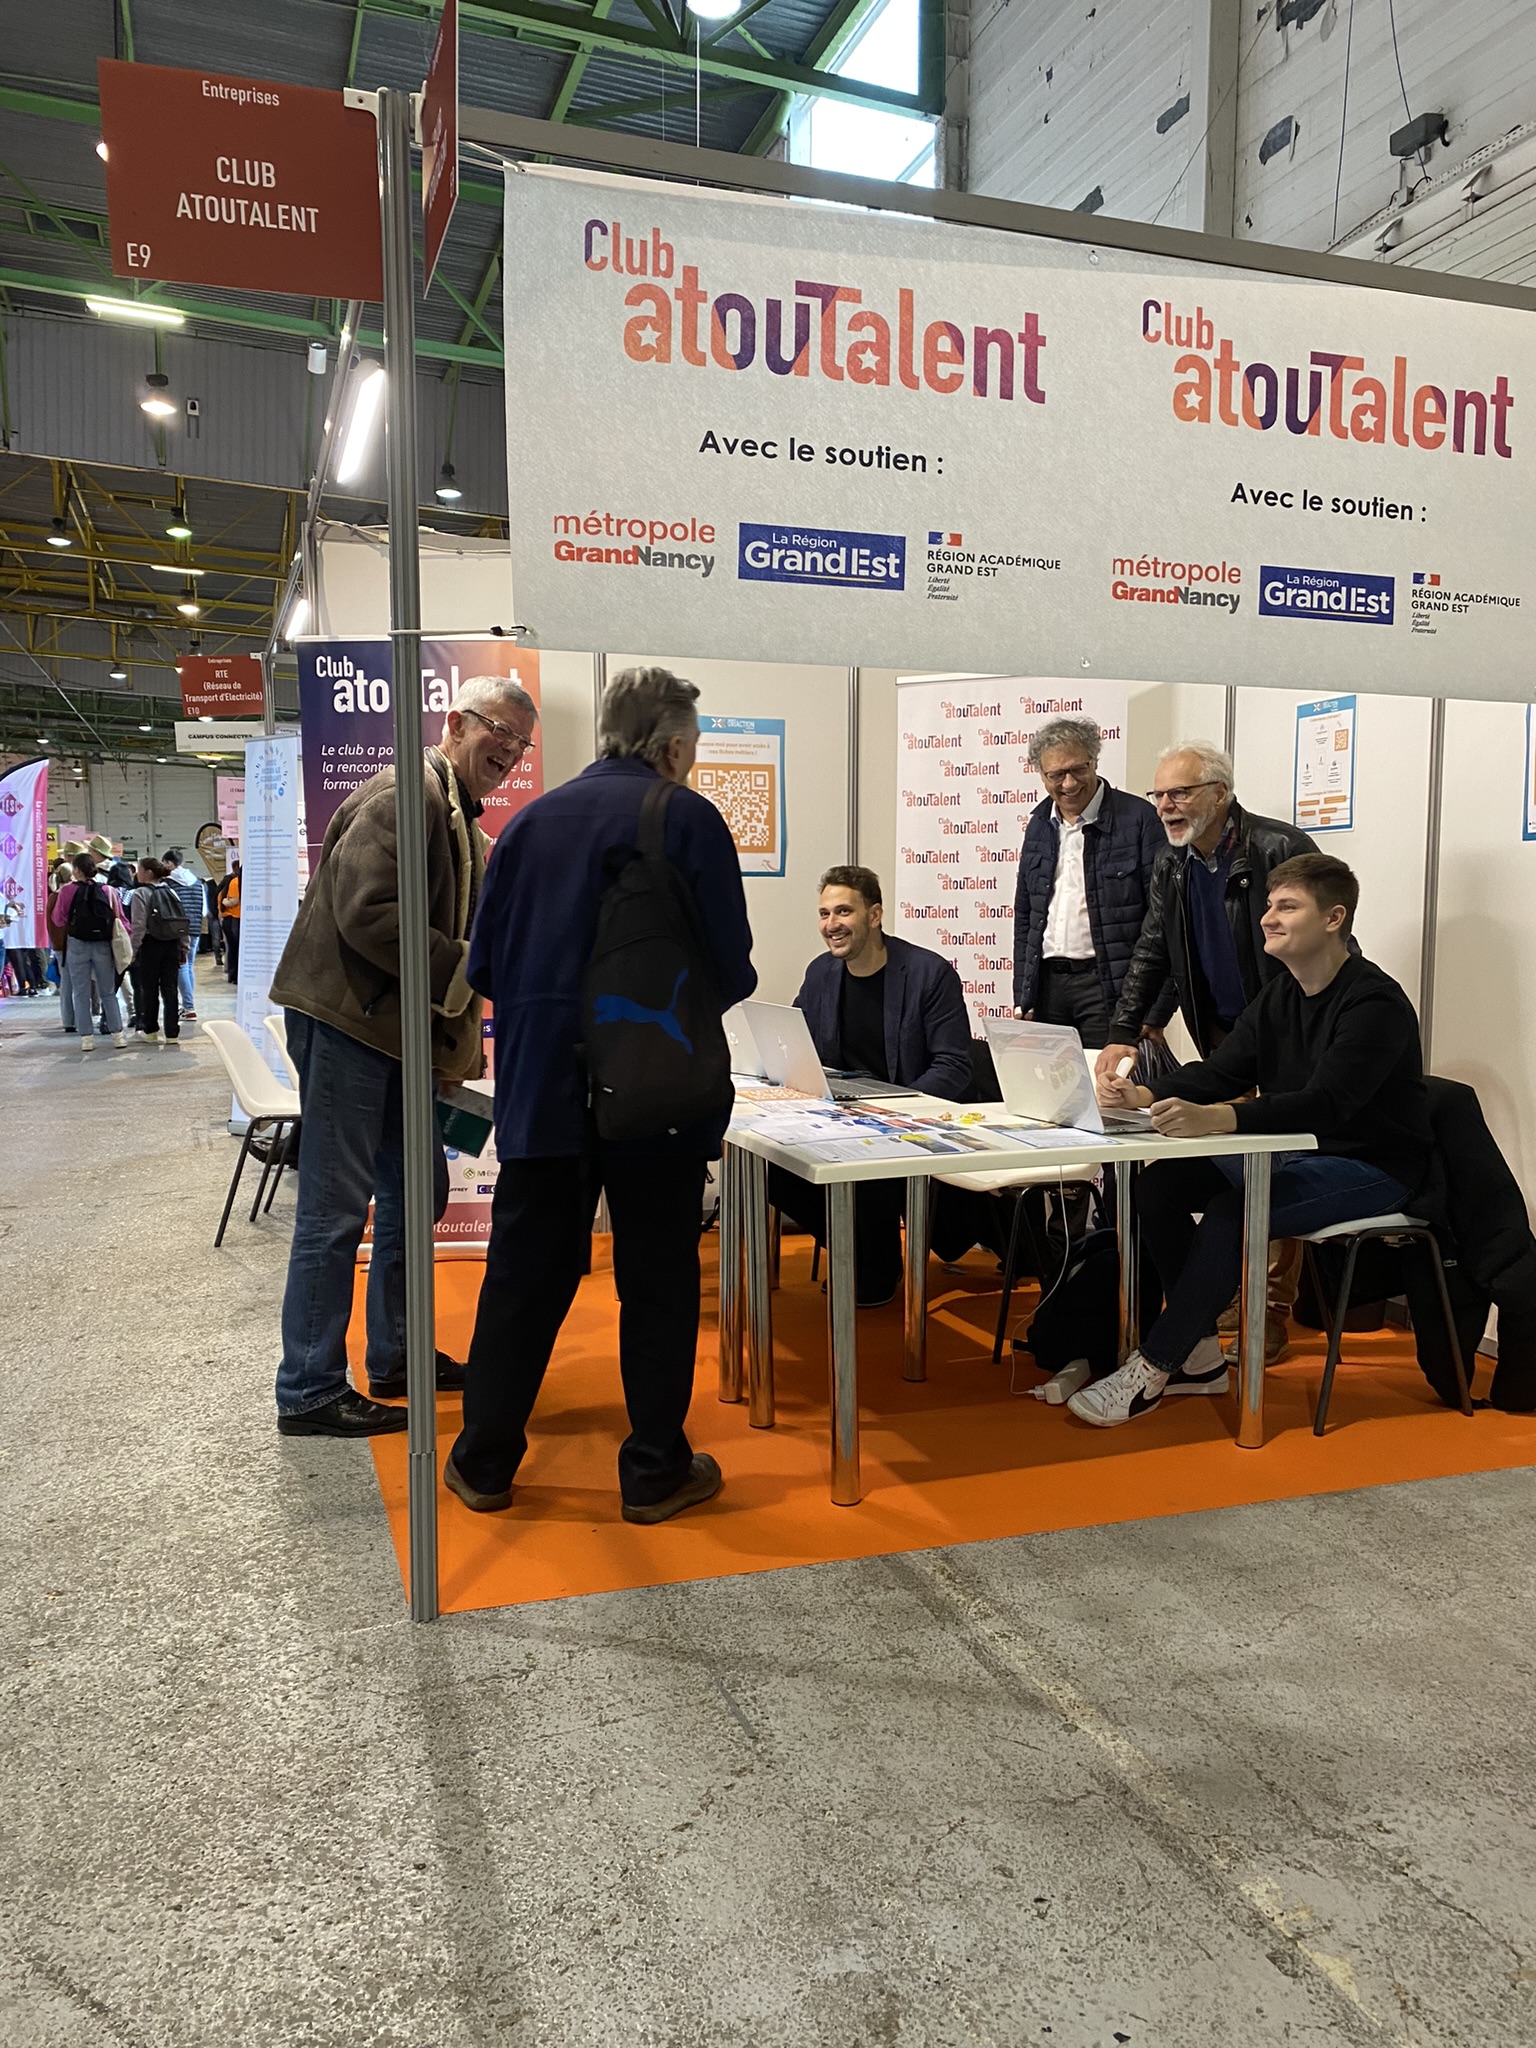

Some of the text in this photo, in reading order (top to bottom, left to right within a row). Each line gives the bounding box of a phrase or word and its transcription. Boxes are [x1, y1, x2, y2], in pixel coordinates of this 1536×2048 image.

[201, 80, 280, 107] Entreprises
[215, 156, 277, 189] CLUB
[176, 192, 320, 234] ATOUTALENT
[126, 242, 152, 269] E9
[583, 218, 674, 279] Club
[623, 265, 1047, 404] atouTalent
[1142, 299, 1214, 350] Club
[1172, 338, 1515, 459] atouTalent
[699, 430, 778, 460] Avec
[789, 437, 815, 462] le
[825, 444, 927, 473] soutien
[1230, 482, 1294, 509] Avec
[1302, 489, 1323, 511] le
[1330, 495, 1414, 521] soutien
[553, 510, 715, 545] métropole
[772, 532, 837, 549] La Région
[927, 548, 1061, 570] RÉGION ACADÉMIQUE
[926, 563, 998, 577] GRAND EST
[927, 576, 950, 584] Liberté
[1112, 554, 1241, 586] métropole
[1286, 574, 1339, 588] La Région
[1411, 601, 1469, 613] GRAND EST
[1412, 587, 1520, 607] RÉGION ACADÉMIQUE
[215, 670, 229, 678] RTE
[316, 655, 354, 678] Club
[203, 682, 241, 691] (Réseau de
[184, 694, 218, 704] Transport
[187, 707, 200, 715] E10
[321, 745, 335, 756] Le
[338, 744, 364, 756] club
[367, 747, 375, 756] a
[322, 761, 334, 773] la
[521, 760, 532, 772] la
[512, 777, 533, 789] des
